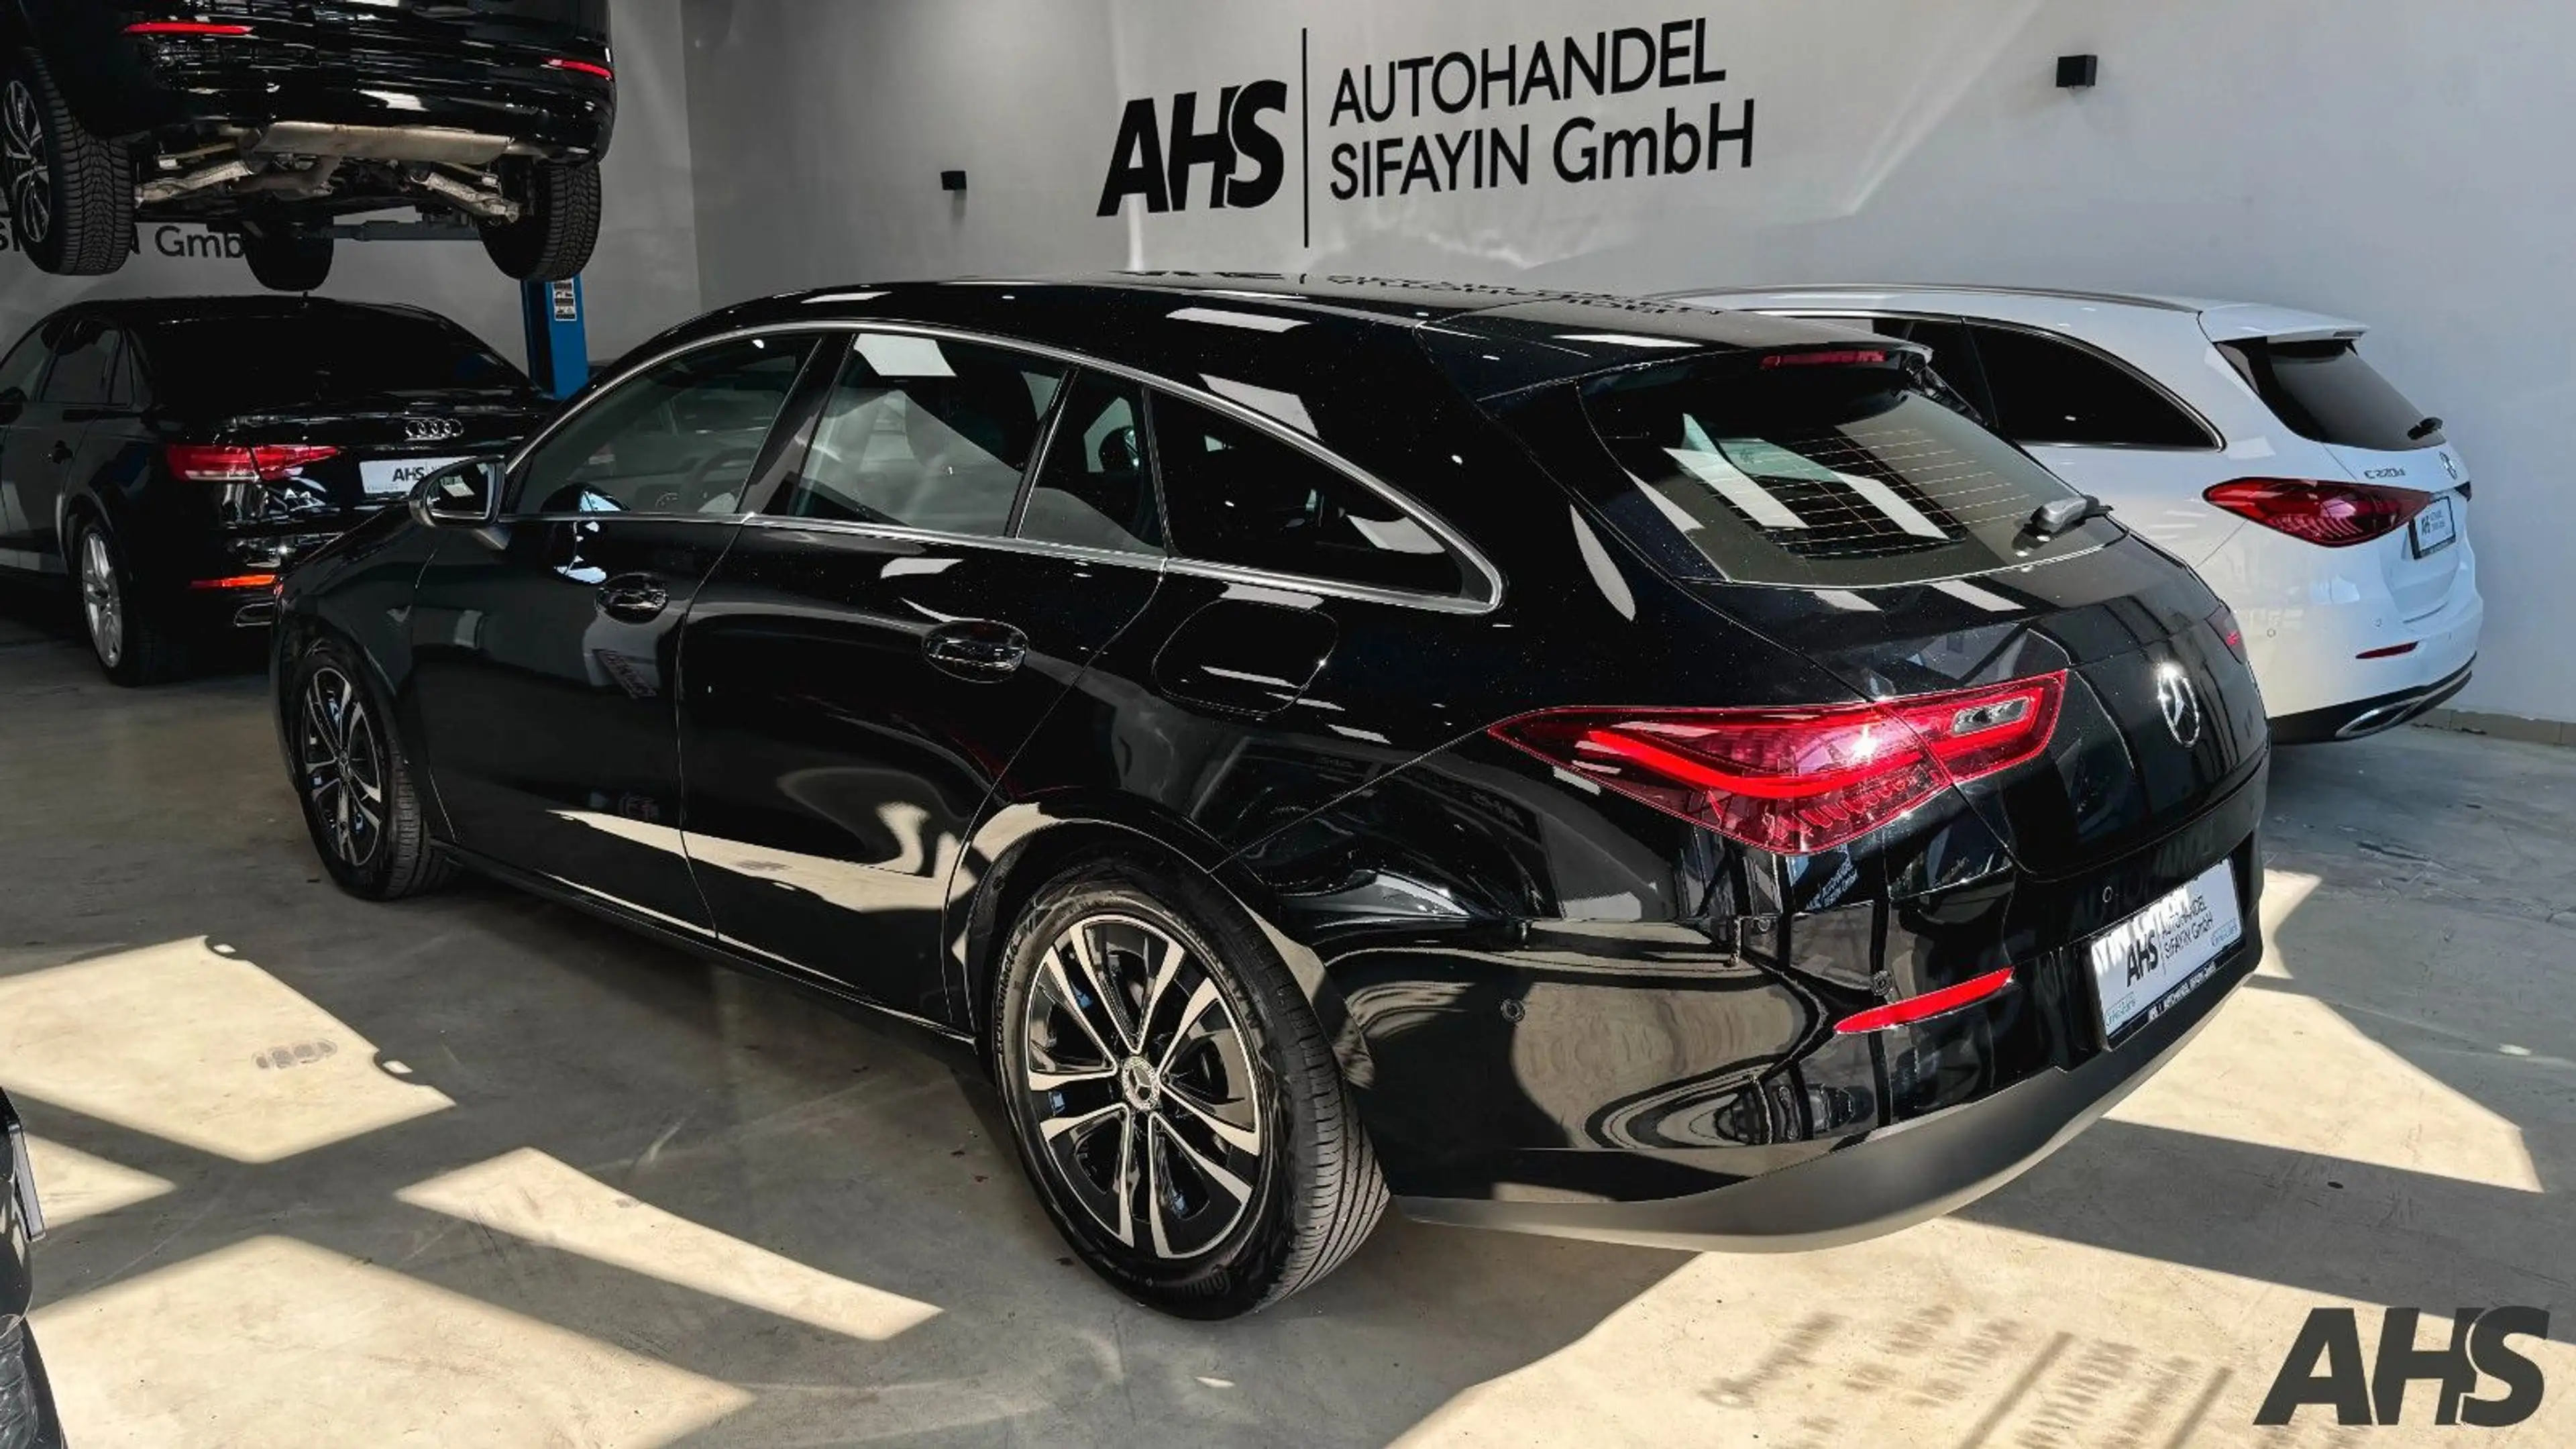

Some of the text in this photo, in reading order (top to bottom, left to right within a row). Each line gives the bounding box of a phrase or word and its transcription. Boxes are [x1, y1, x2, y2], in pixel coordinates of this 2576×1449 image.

[1330, 18, 1726, 127] AUTOHANDEL
[1096, 80, 1287, 217] AHS
[1330, 99, 1754, 200] SIFAYIN GmbH
[392, 467, 425, 482] AHS
[2126, 929, 2159, 988] AHS
